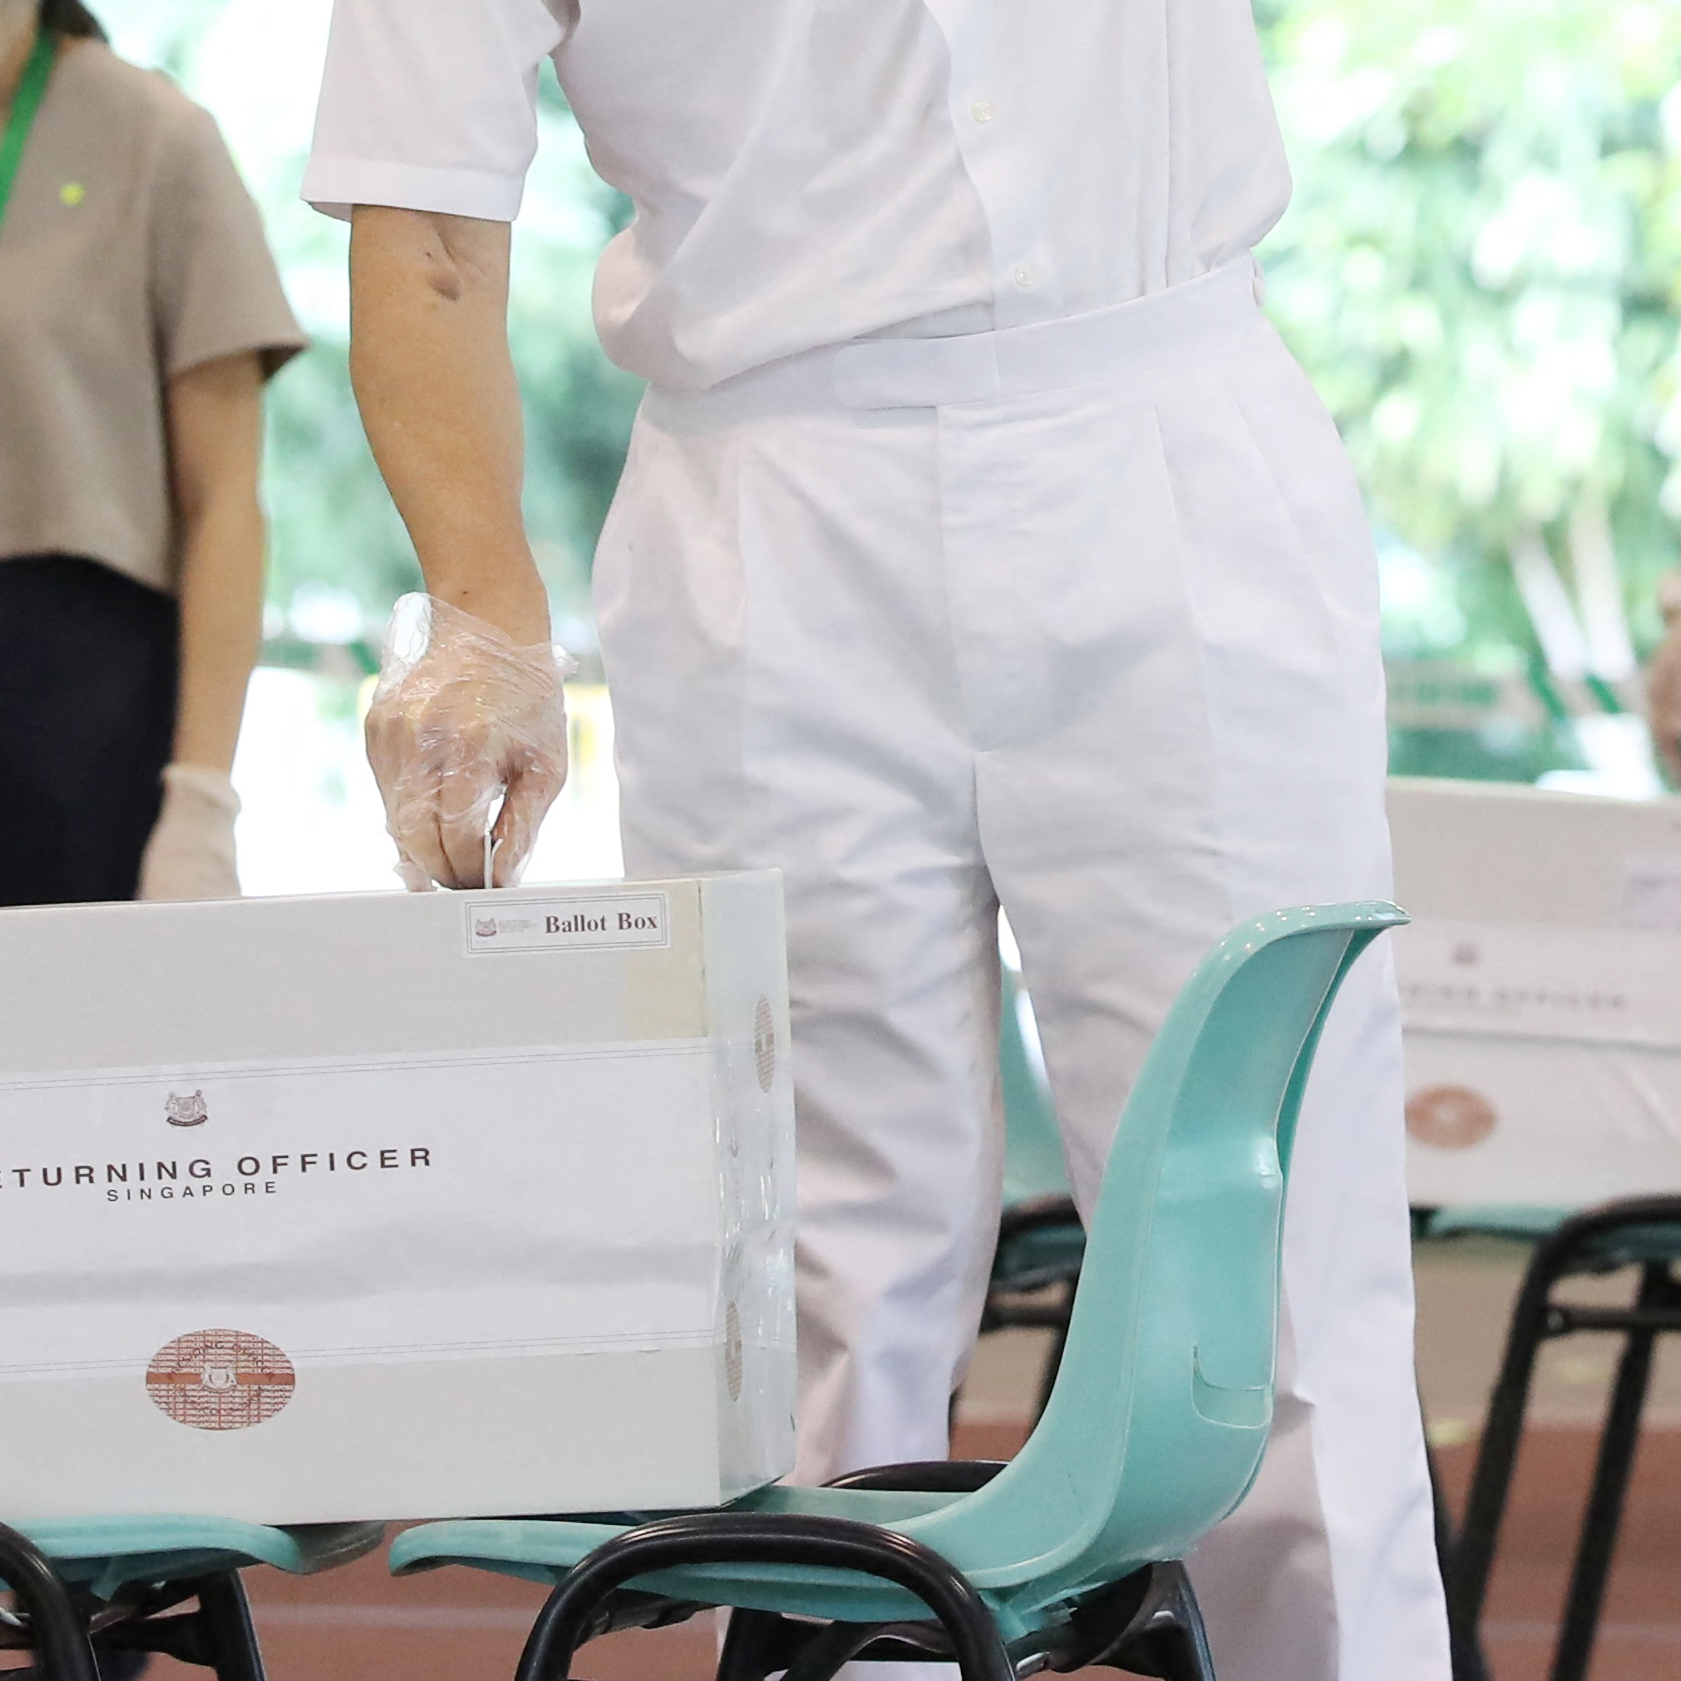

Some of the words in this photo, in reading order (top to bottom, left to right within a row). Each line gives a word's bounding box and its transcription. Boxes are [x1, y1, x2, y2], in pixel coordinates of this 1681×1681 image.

[545, 914, 607, 934] Ballot
[617, 912, 658, 931] Box
[237, 1147, 431, 1177] OFFICER
[106, 1181, 276, 1202] SINGAPORE
